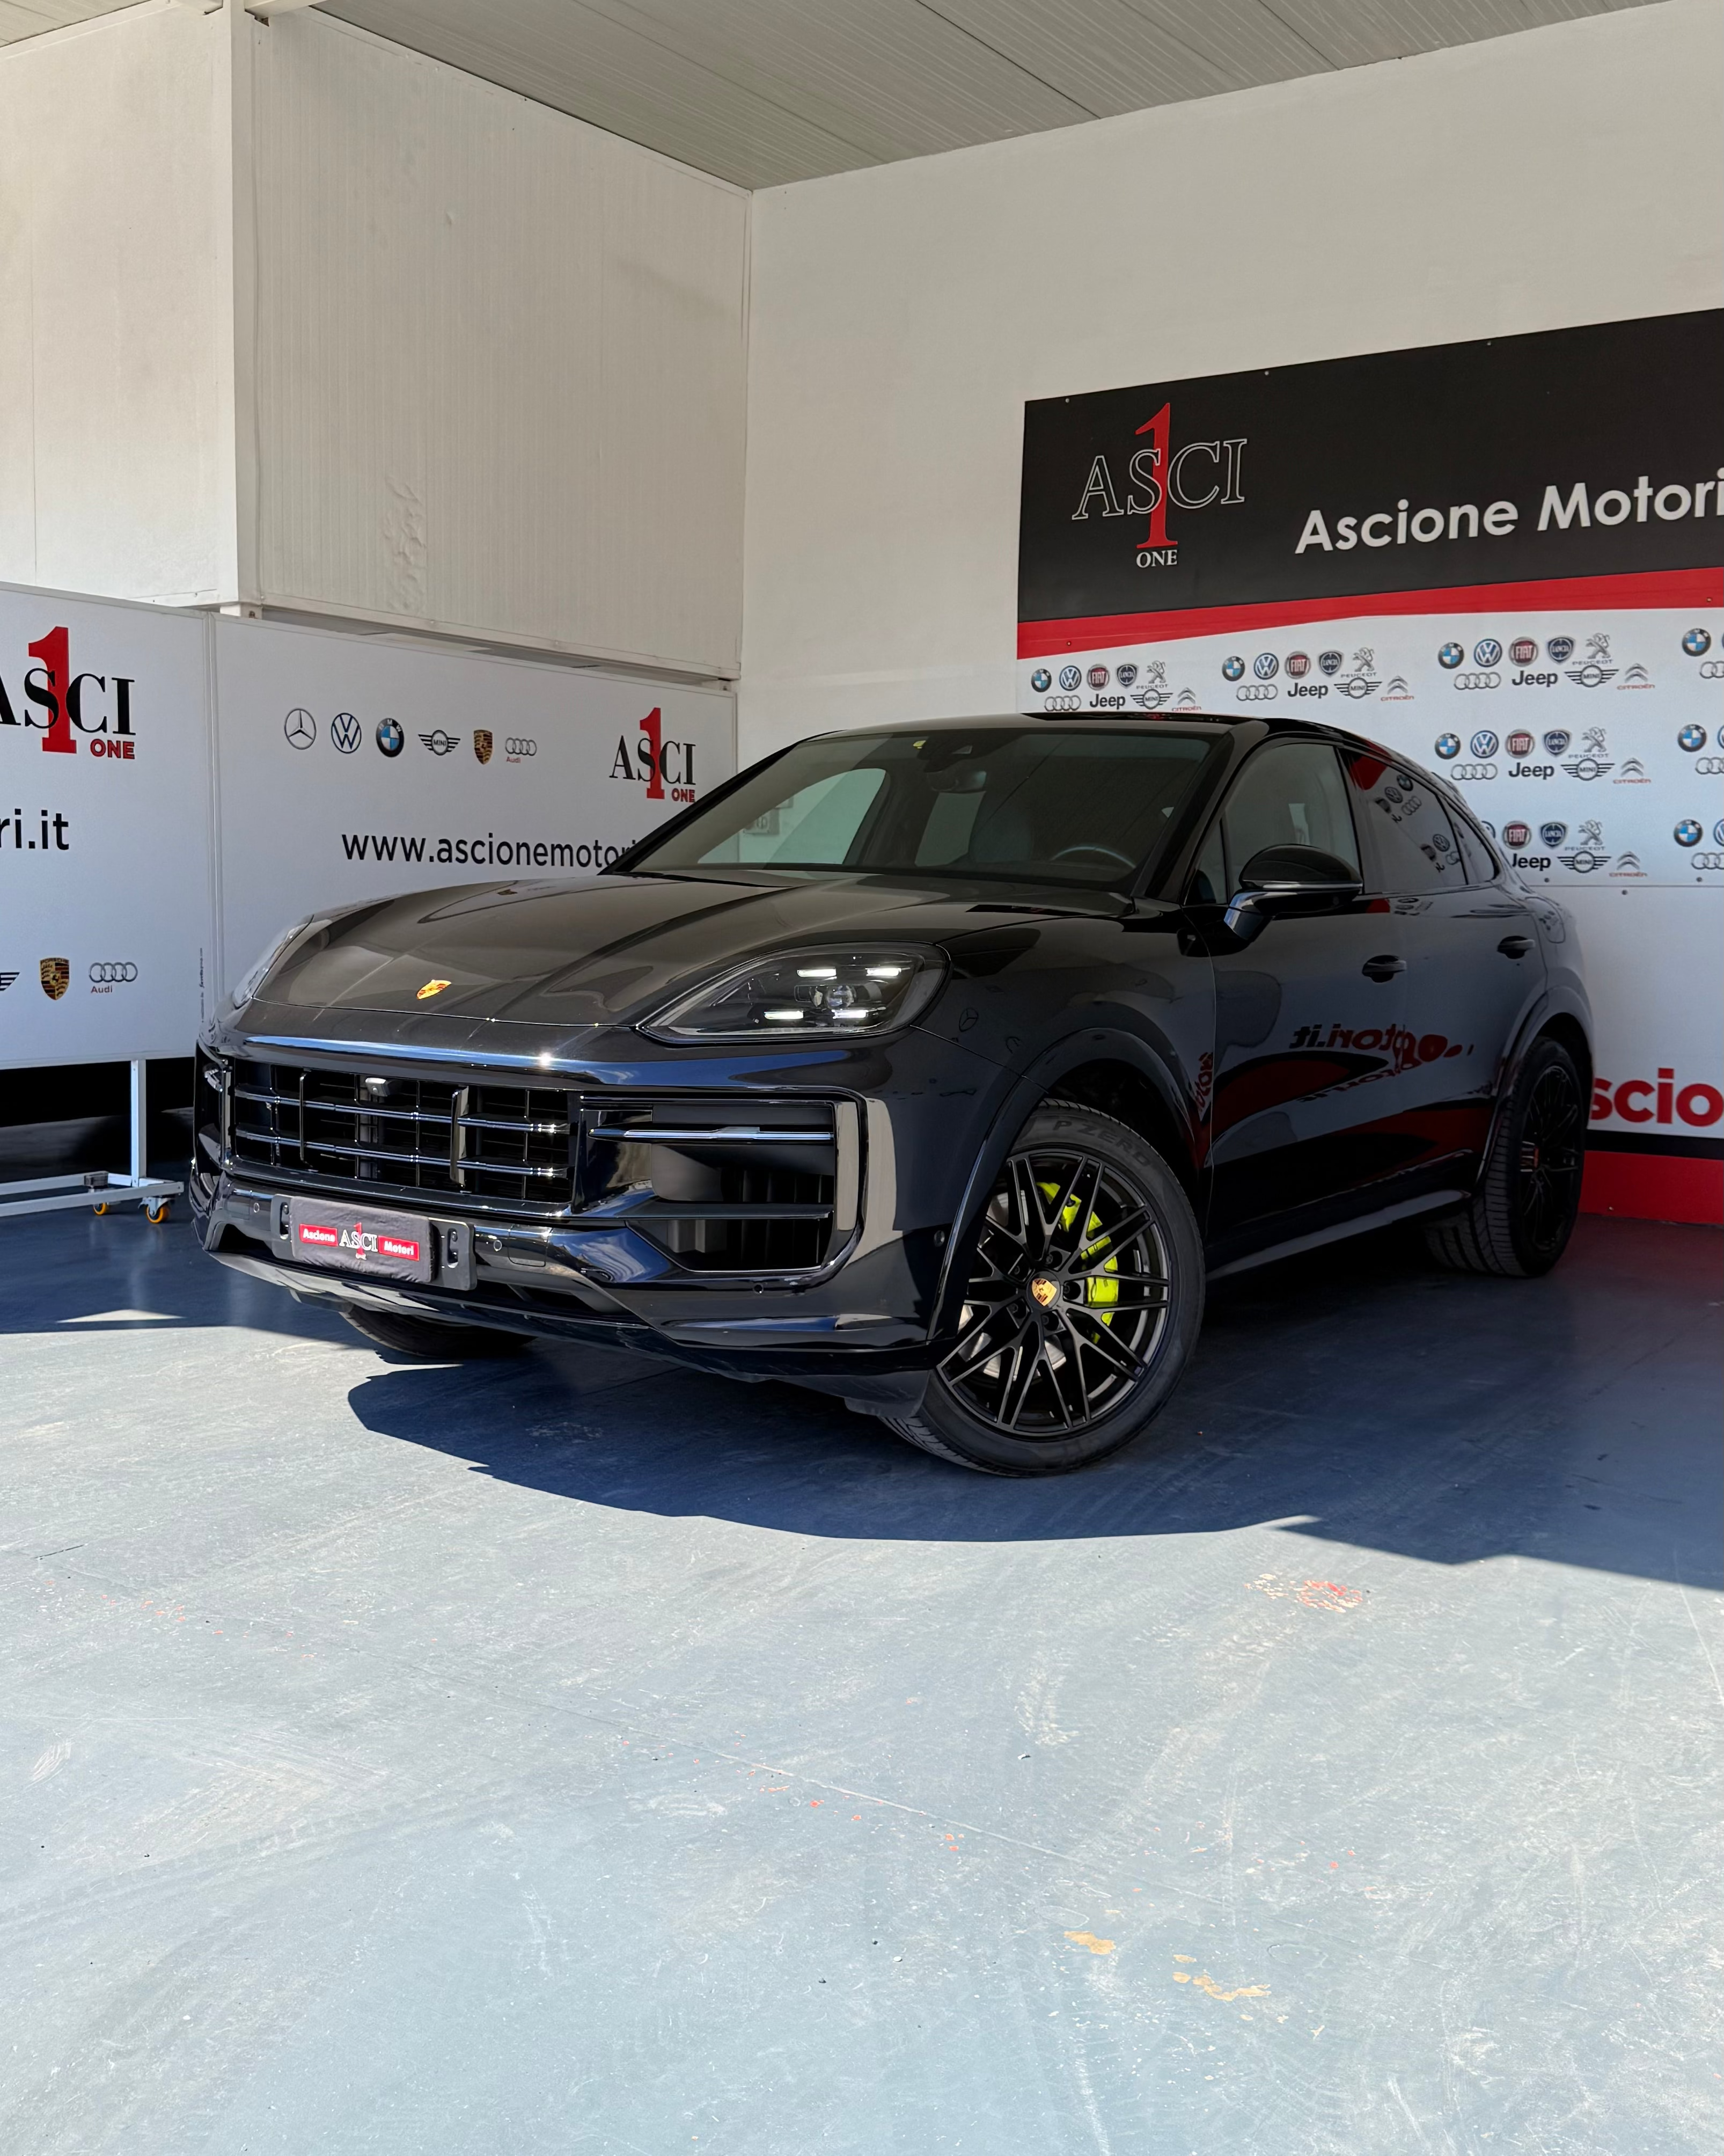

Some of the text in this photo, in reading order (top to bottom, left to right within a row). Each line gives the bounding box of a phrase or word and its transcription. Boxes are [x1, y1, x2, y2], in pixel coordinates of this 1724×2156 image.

[1072, 438, 1247, 520] ASCI
[1295, 467, 1724, 554] Ascione Motori
[1136, 550, 1177, 568] ONE
[1516, 645, 1532, 659] FIAT
[1291, 659, 1307, 673] FIAT
[1092, 671, 1105, 684] FIAT
[1512, 670, 1558, 688] Jeep
[1288, 683, 1328, 699] Jeep
[1090, 693, 1125, 710] Jeep
[90, 739, 135, 759] ONE
[1512, 737, 1529, 751] FIAT
[609, 735, 696, 785] ASCI
[1508, 763, 1554, 780] Jeep
[672, 788, 695, 803] ONE
[1509, 829, 1525, 842] FIAT
[342, 832, 636, 868] www.ascionemoto
[1512, 853, 1551, 871] Jeep
[339, 1229, 378, 1252] ASCI
[384, 1240, 415, 1255] Motori
